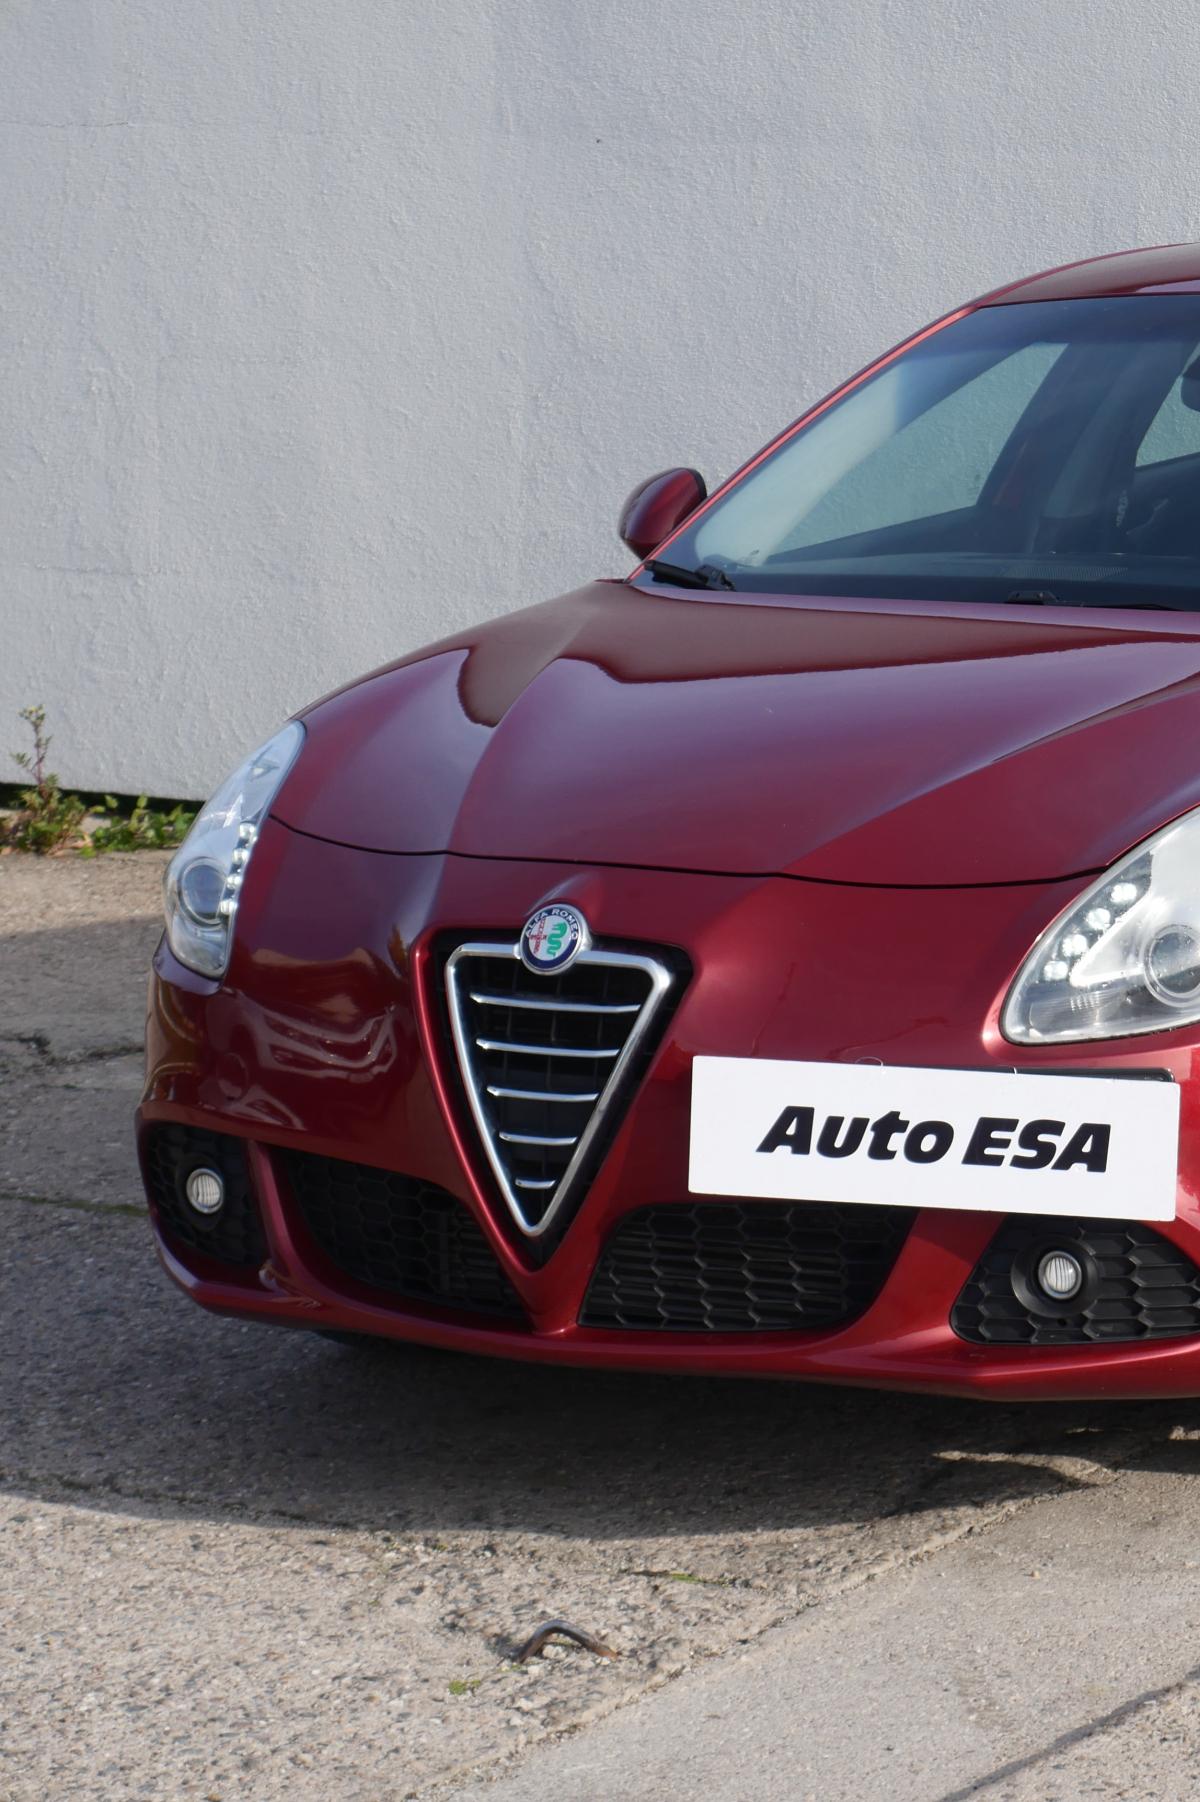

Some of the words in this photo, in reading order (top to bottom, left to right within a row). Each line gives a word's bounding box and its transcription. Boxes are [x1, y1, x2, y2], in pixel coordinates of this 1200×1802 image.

[525, 911, 548, 939] ALFA
[551, 908, 579, 940] ROMEO
[756, 1105, 954, 1163] Auto
[961, 1116, 1111, 1173] ESA
